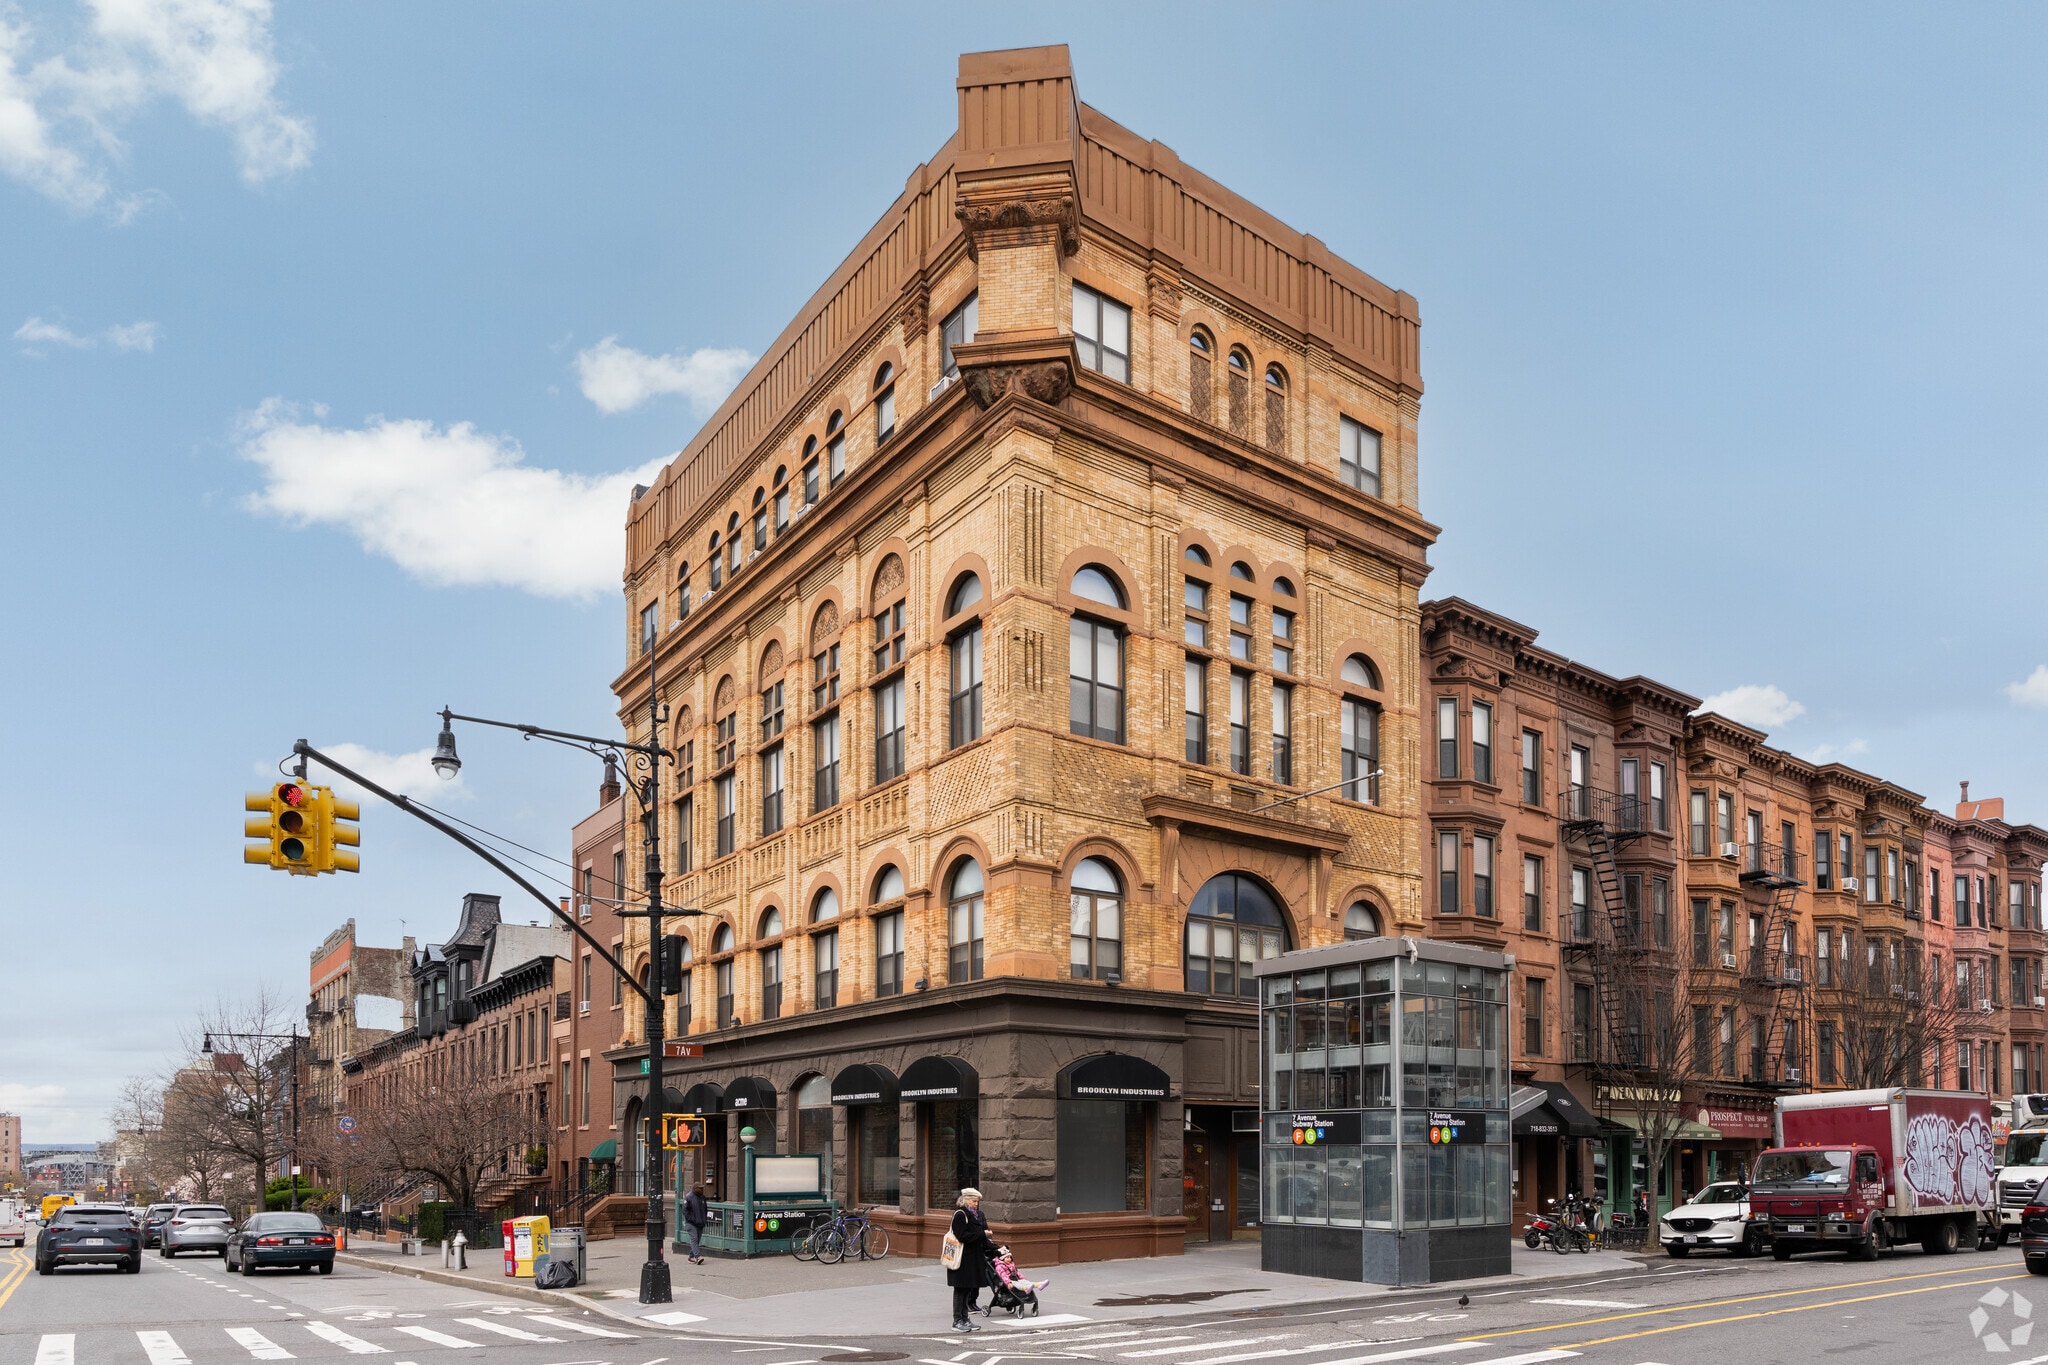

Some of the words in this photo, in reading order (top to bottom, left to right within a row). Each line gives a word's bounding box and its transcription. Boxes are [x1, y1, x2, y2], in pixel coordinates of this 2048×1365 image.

[901, 1089, 927, 1097] BROOKLYN
[927, 1087, 958, 1096] INDUSTRIES
[1077, 1086, 1119, 1094] BROOKLYN
[1120, 1088, 1165, 1096] INDUSTRIES
[854, 1092, 880, 1100] INDUSTRIES
[735, 1098, 748, 1107] acme
[1710, 1111, 1742, 1121] PROSPECT
[1292, 1120, 1313, 1128] Subway
[1430, 1119, 1448, 1127] Subway
